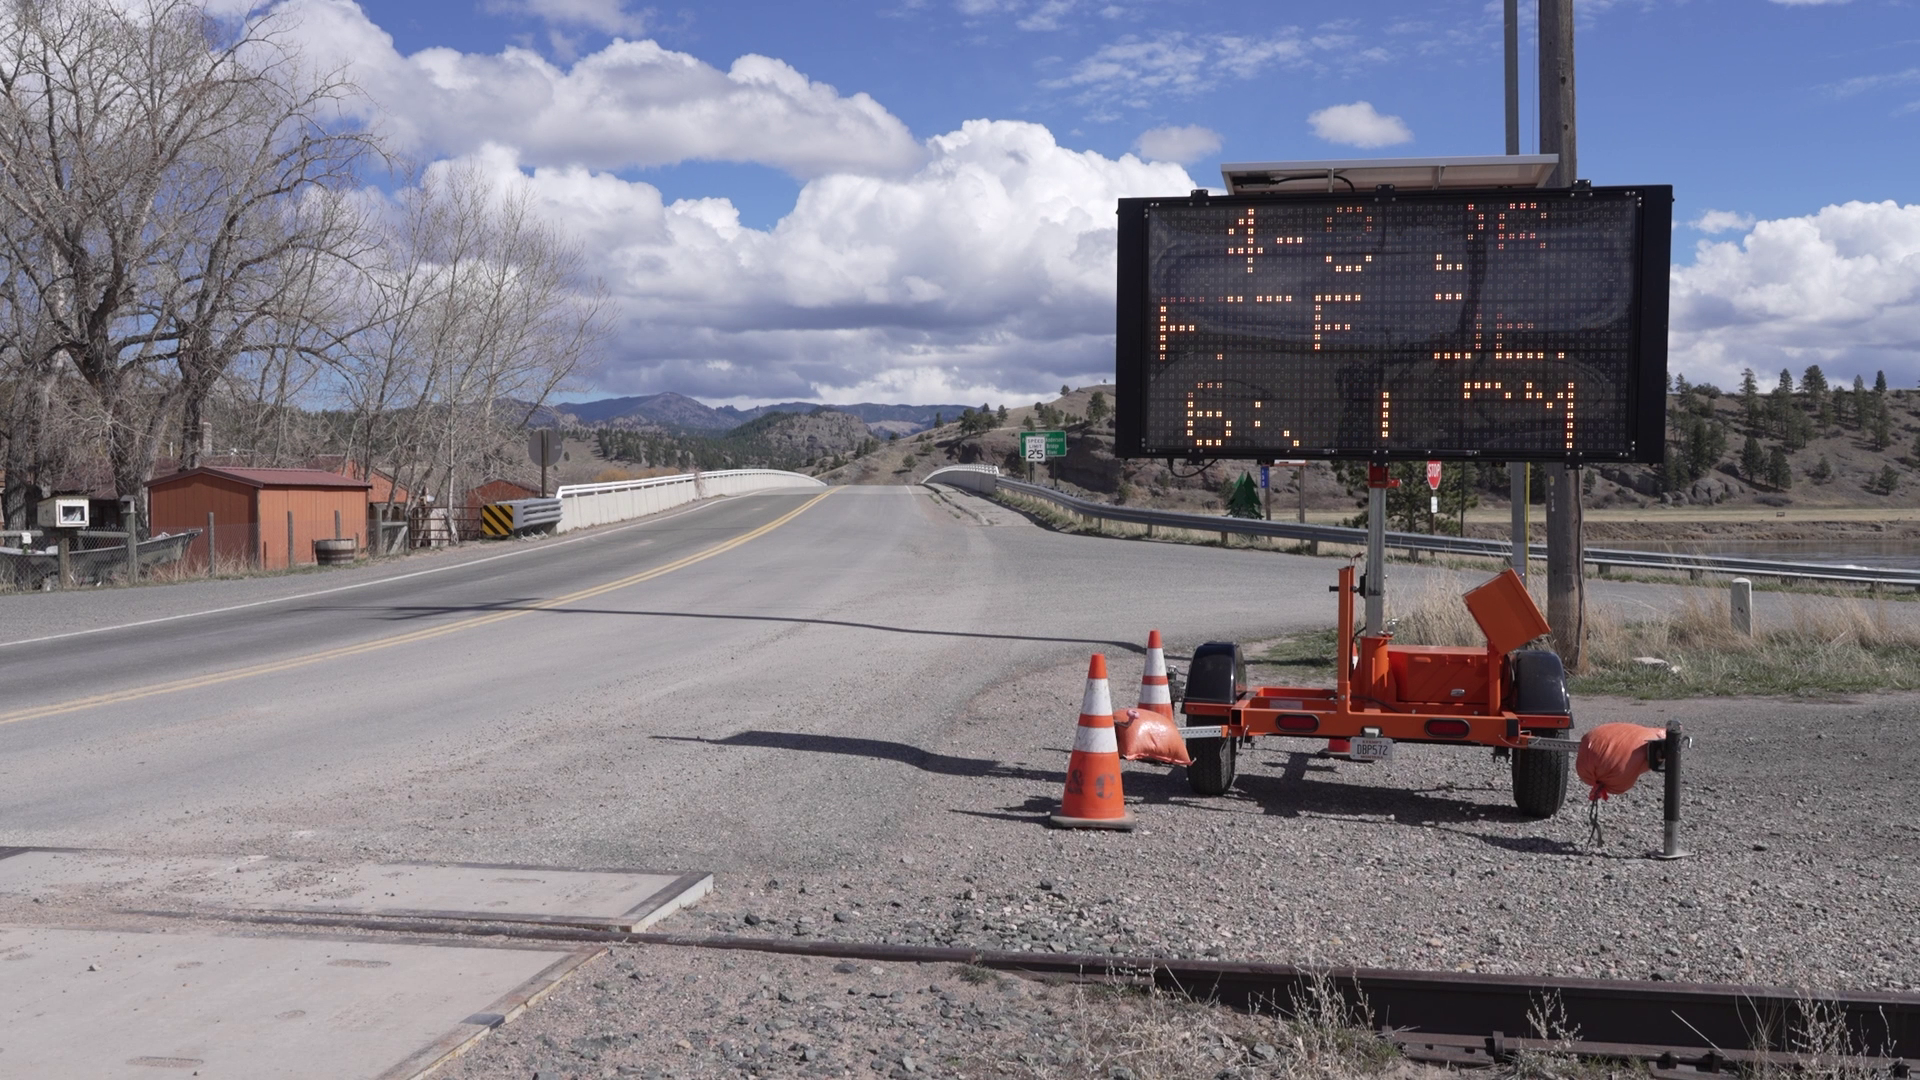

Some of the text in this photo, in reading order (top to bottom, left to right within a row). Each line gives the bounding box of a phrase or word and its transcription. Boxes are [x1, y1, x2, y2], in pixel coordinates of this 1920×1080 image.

[1028, 449, 1044, 459] 25
[1428, 463, 1440, 477] STOP
[1357, 744, 1388, 755] DBP572
